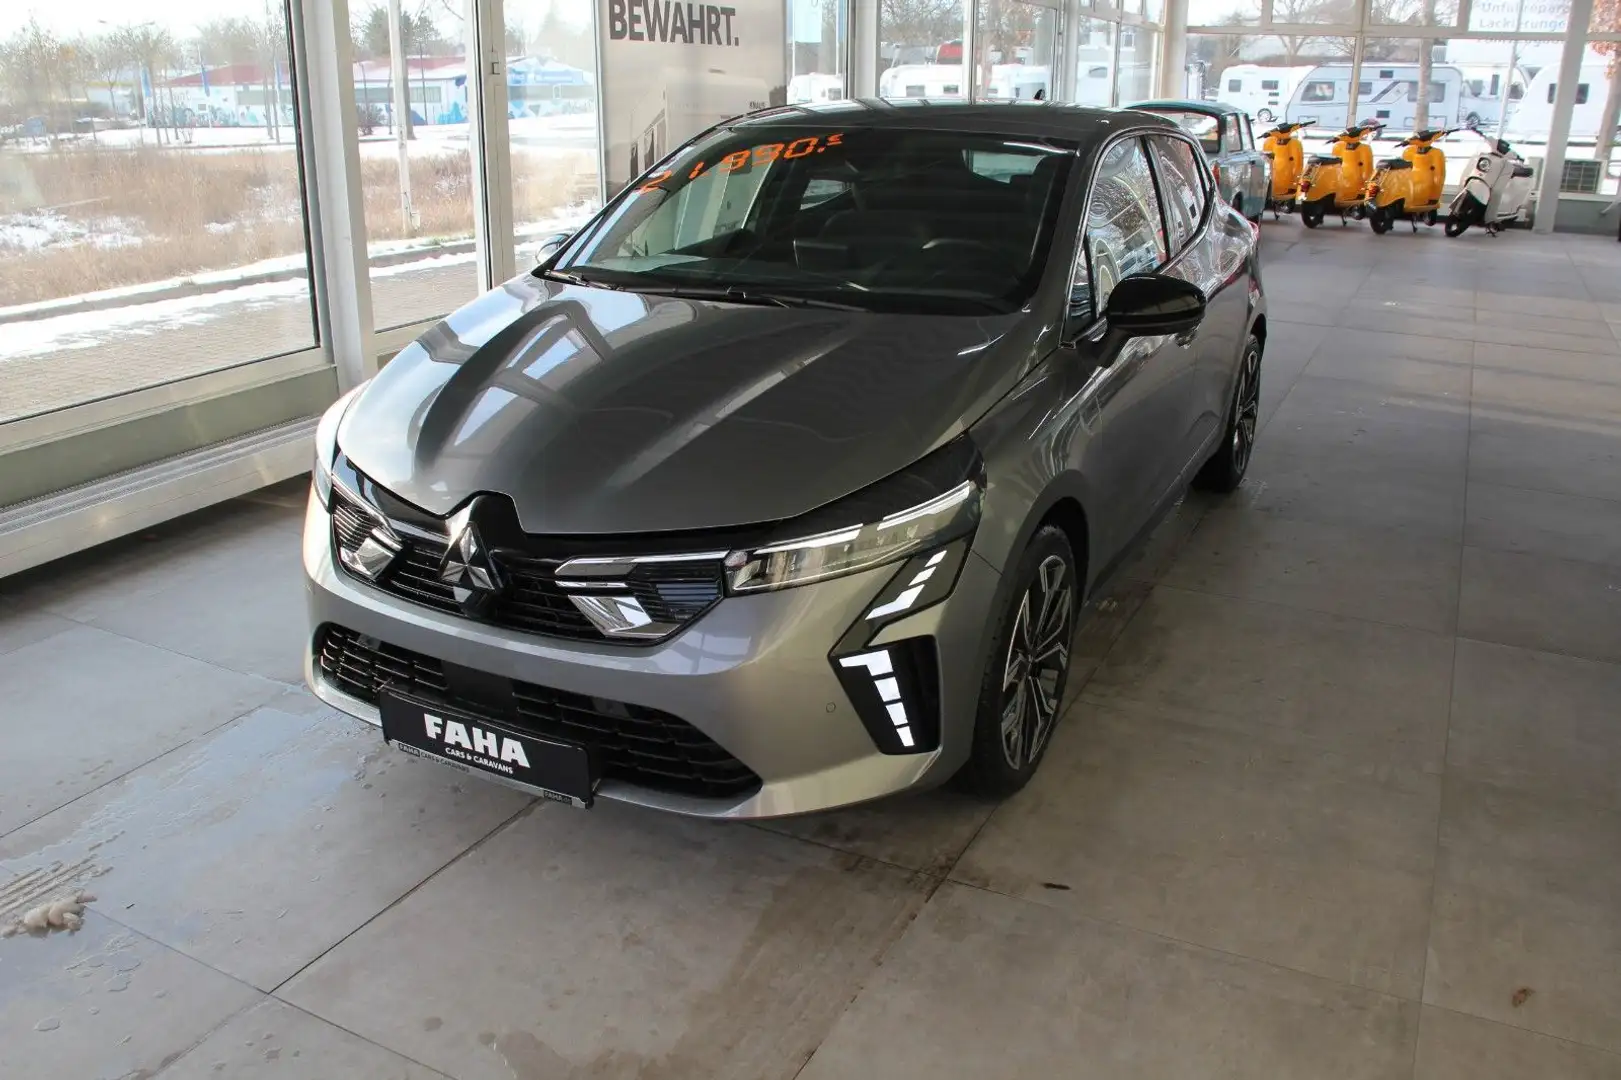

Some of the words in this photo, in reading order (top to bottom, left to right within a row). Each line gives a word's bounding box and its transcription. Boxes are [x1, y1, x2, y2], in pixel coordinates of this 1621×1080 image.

[609, 0, 740, 47] BEWAHRT.
[423, 713, 531, 769] FAHA
[445, 746, 466, 760] CARS
[473, 755, 514, 775] CARAVANS
